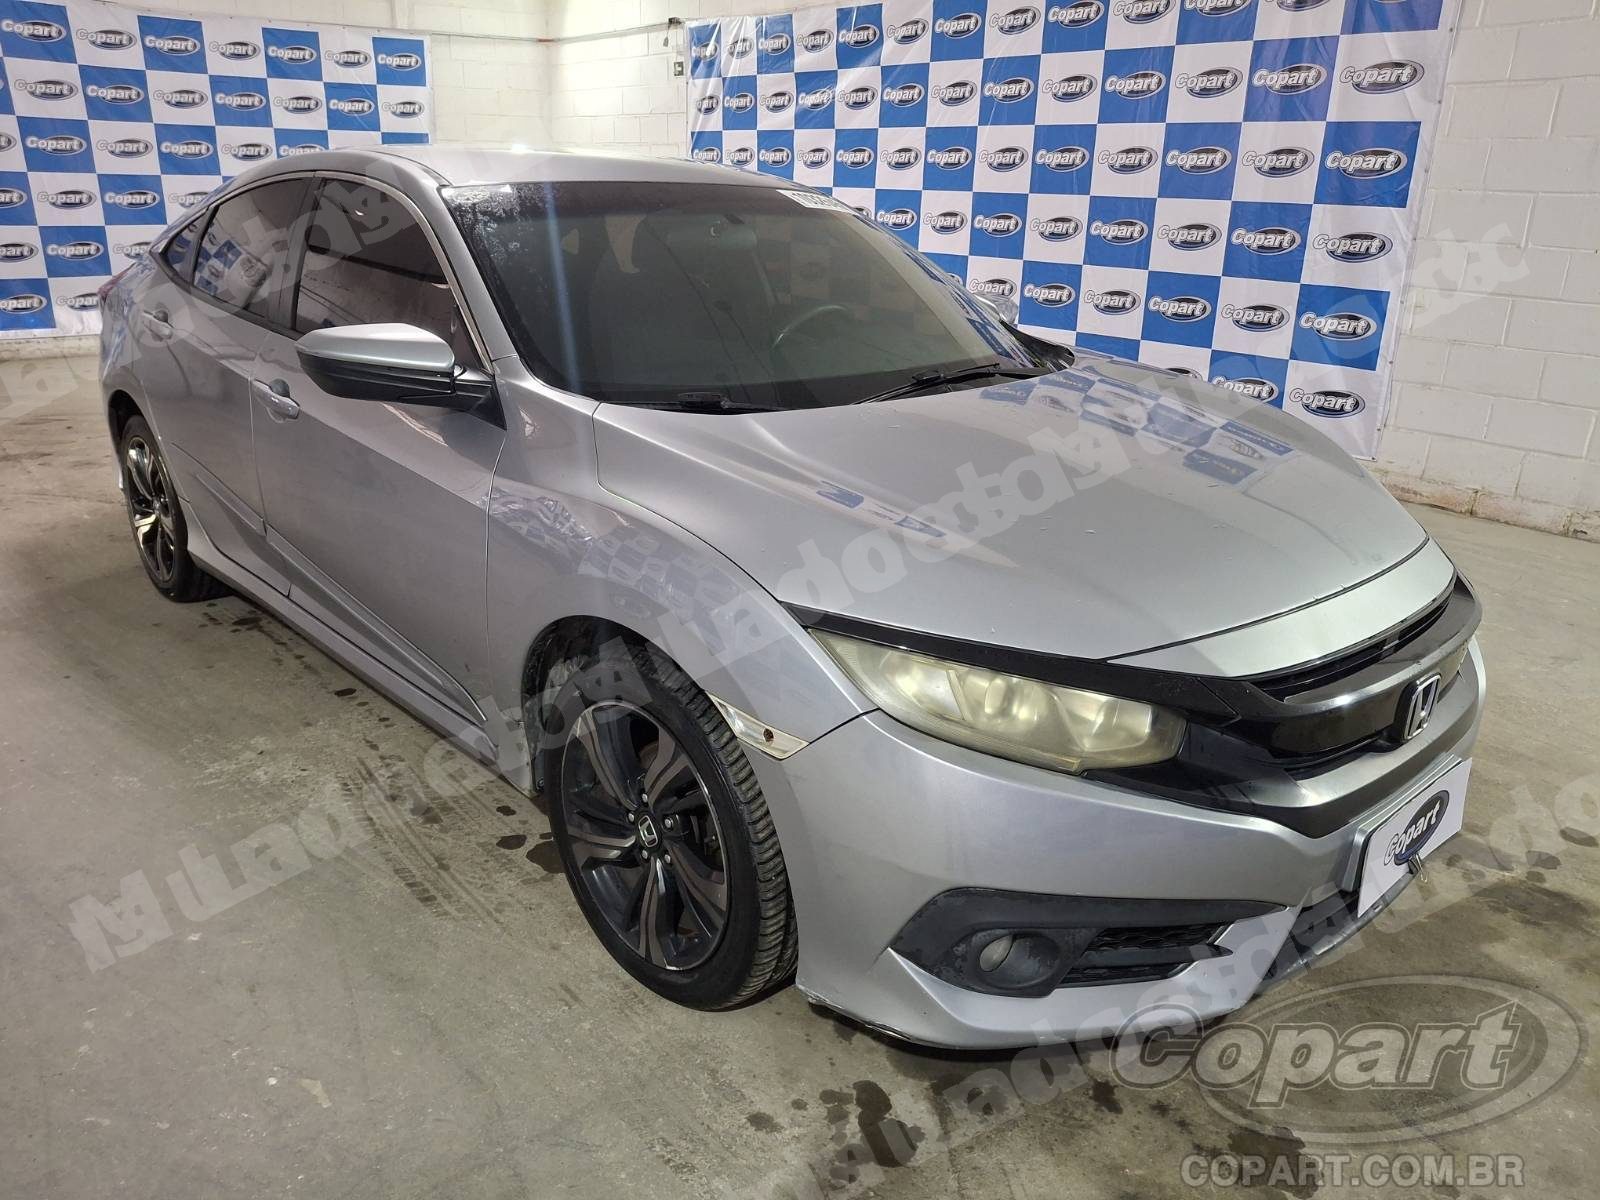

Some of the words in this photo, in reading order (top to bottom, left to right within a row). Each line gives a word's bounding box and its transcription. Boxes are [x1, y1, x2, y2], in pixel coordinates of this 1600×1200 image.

[990, 9, 1033, 29] Copart
[1048, 4, 1099, 21] Copart
[1, 20, 60, 36] Copart
[887, 22, 923, 38] Copart
[935, 16, 976, 33] Copart
[76, 29, 130, 45] Copart
[144, 36, 194, 51] Copart
[796, 32, 829, 46] Copart
[839, 28, 875, 43] Copart
[209, 41, 255, 56] Copart
[268, 46, 311, 59] Copart
[325, 50, 366, 63] Copart
[377, 54, 418, 66] Copart
[1175, 71, 1234, 91] Copart
[1253, 67, 1320, 89] Copart
[1340, 64, 1415, 87] Copart
[14, 79, 73, 95] Copart
[931, 83, 972, 101] Copart
[983, 80, 1028, 98] Copart
[1042, 79, 1091, 96] Copart
[1105, 75, 1160, 93] Copart
[87, 85, 138, 100] Copart
[153, 90, 200, 104] Copart
[215, 93, 260, 106] Copart
[838, 90, 874, 105] Copart
[883, 87, 921, 102] Copart
[274, 96, 317, 109] Copart
[329, 99, 370, 111] Copart
[382, 102, 421, 114] Copart
[725, 95, 750, 108] Copart
[760, 95, 789, 108] Copart
[27, 136, 80, 152] Copart
[97, 140, 147, 154] Copart
[160, 142, 208, 156] Copart
[222, 144, 269, 156] Copart
[692, 149, 718, 161] Copart
[725, 149, 751, 162] Copart
[759, 149, 788, 163] Copart
[797, 149, 829, 164] Copart
[836, 149, 869, 164] Copart
[880, 149, 918, 165] Copart
[927, 149, 970, 165] Copart
[978, 149, 1023, 167] Copart
[1036, 149, 1084, 166] Copart
[1098, 150, 1152, 167] Copart
[1166, 150, 1225, 168] Copart
[1242, 151, 1305, 171] Copart
[1325, 150, 1397, 173] Copart
[37, 192, 88, 206] Copart
[104, 192, 154, 206] Copart
[876, 210, 912, 225] Copart
[923, 212, 962, 227] Copart
[974, 214, 1016, 231] Copart
[1030, 217, 1077, 234] Copart
[1090, 220, 1143, 238] Copart
[1157, 225, 1213, 243] Copart
[1231, 227, 1295, 248] Copart
[1313, 233, 1384, 254] Copart
[47, 244, 97, 259] Copart
[969, 279, 1011, 295] Copart
[1023, 283, 1070, 301] Copart
[0, 296, 41, 310] opart
[56, 296, 98, 308] Copar
[1084, 289, 1135, 308] Copart
[1148, 296, 1206, 315] Copart
[1221, 303, 1281, 324] Copart
[1299, 311, 1369, 336] Copart
[1289, 387, 1356, 412] Copart
[1384, 800, 1441, 866] Copart
